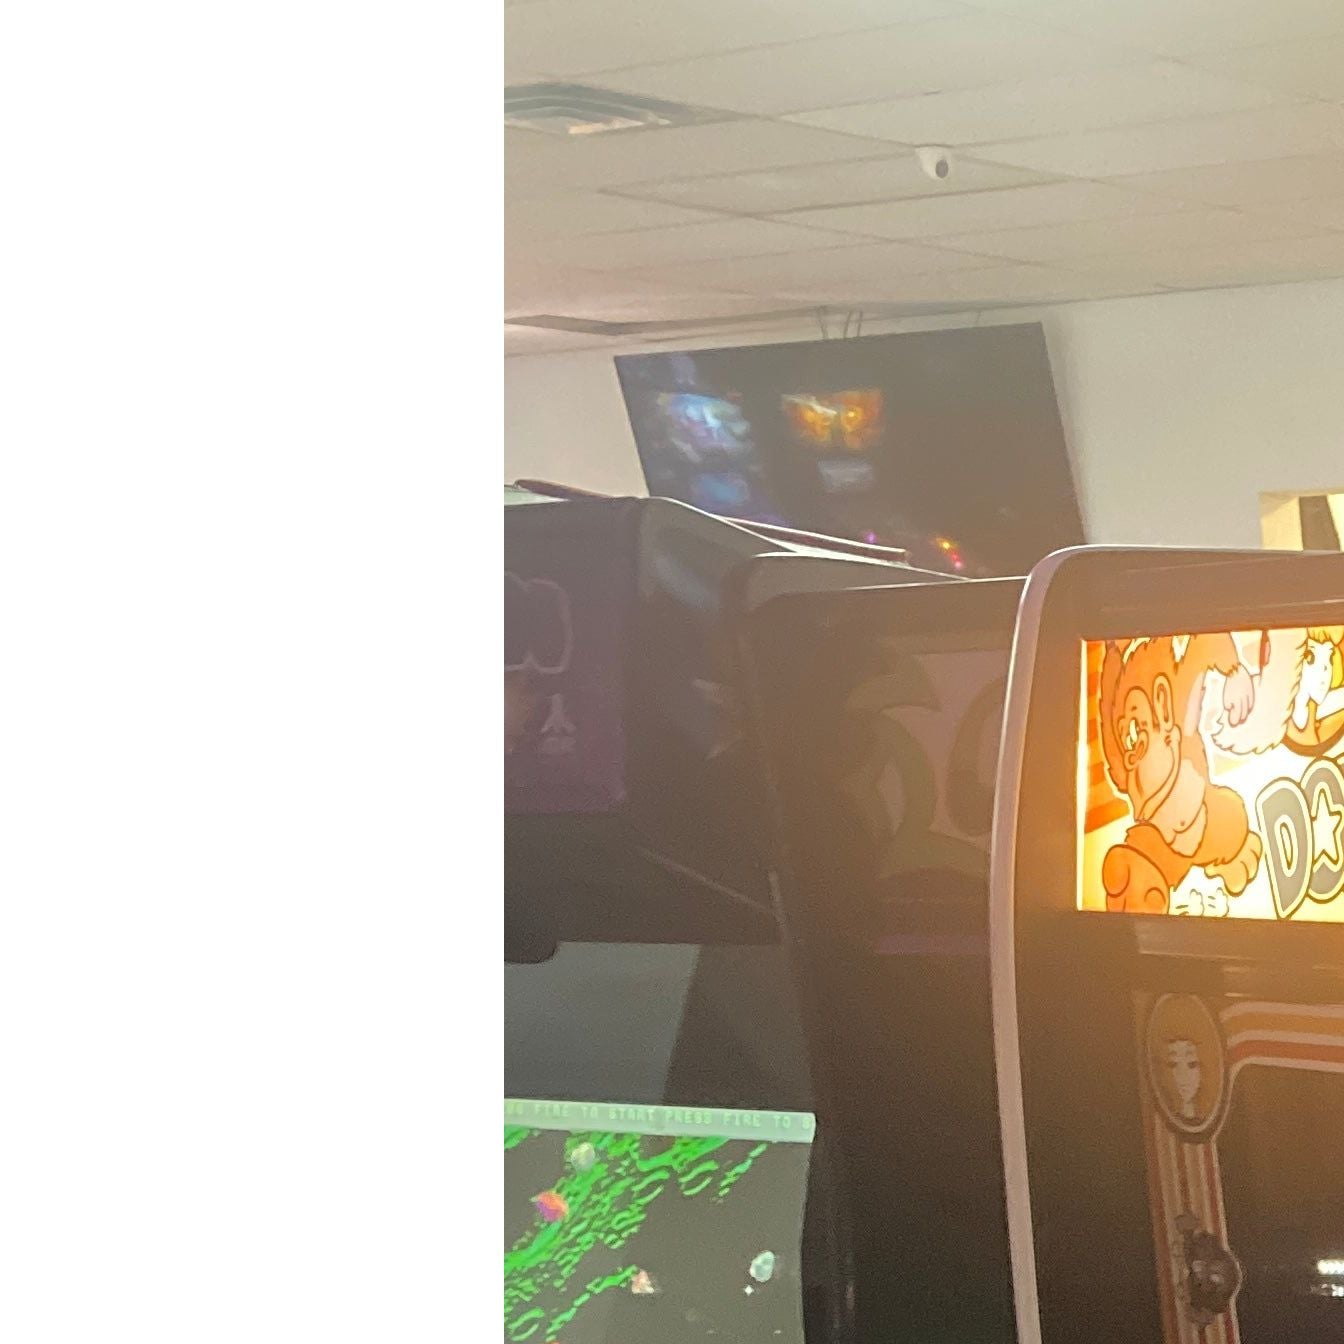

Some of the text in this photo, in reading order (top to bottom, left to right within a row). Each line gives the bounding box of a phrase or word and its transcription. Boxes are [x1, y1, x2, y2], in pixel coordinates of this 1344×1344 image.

[608, 1107, 655, 1121] START
[664, 1109, 713, 1125] PRESS
[722, 1111, 760, 1127] FIRE
[773, 1114, 792, 1129] TO
